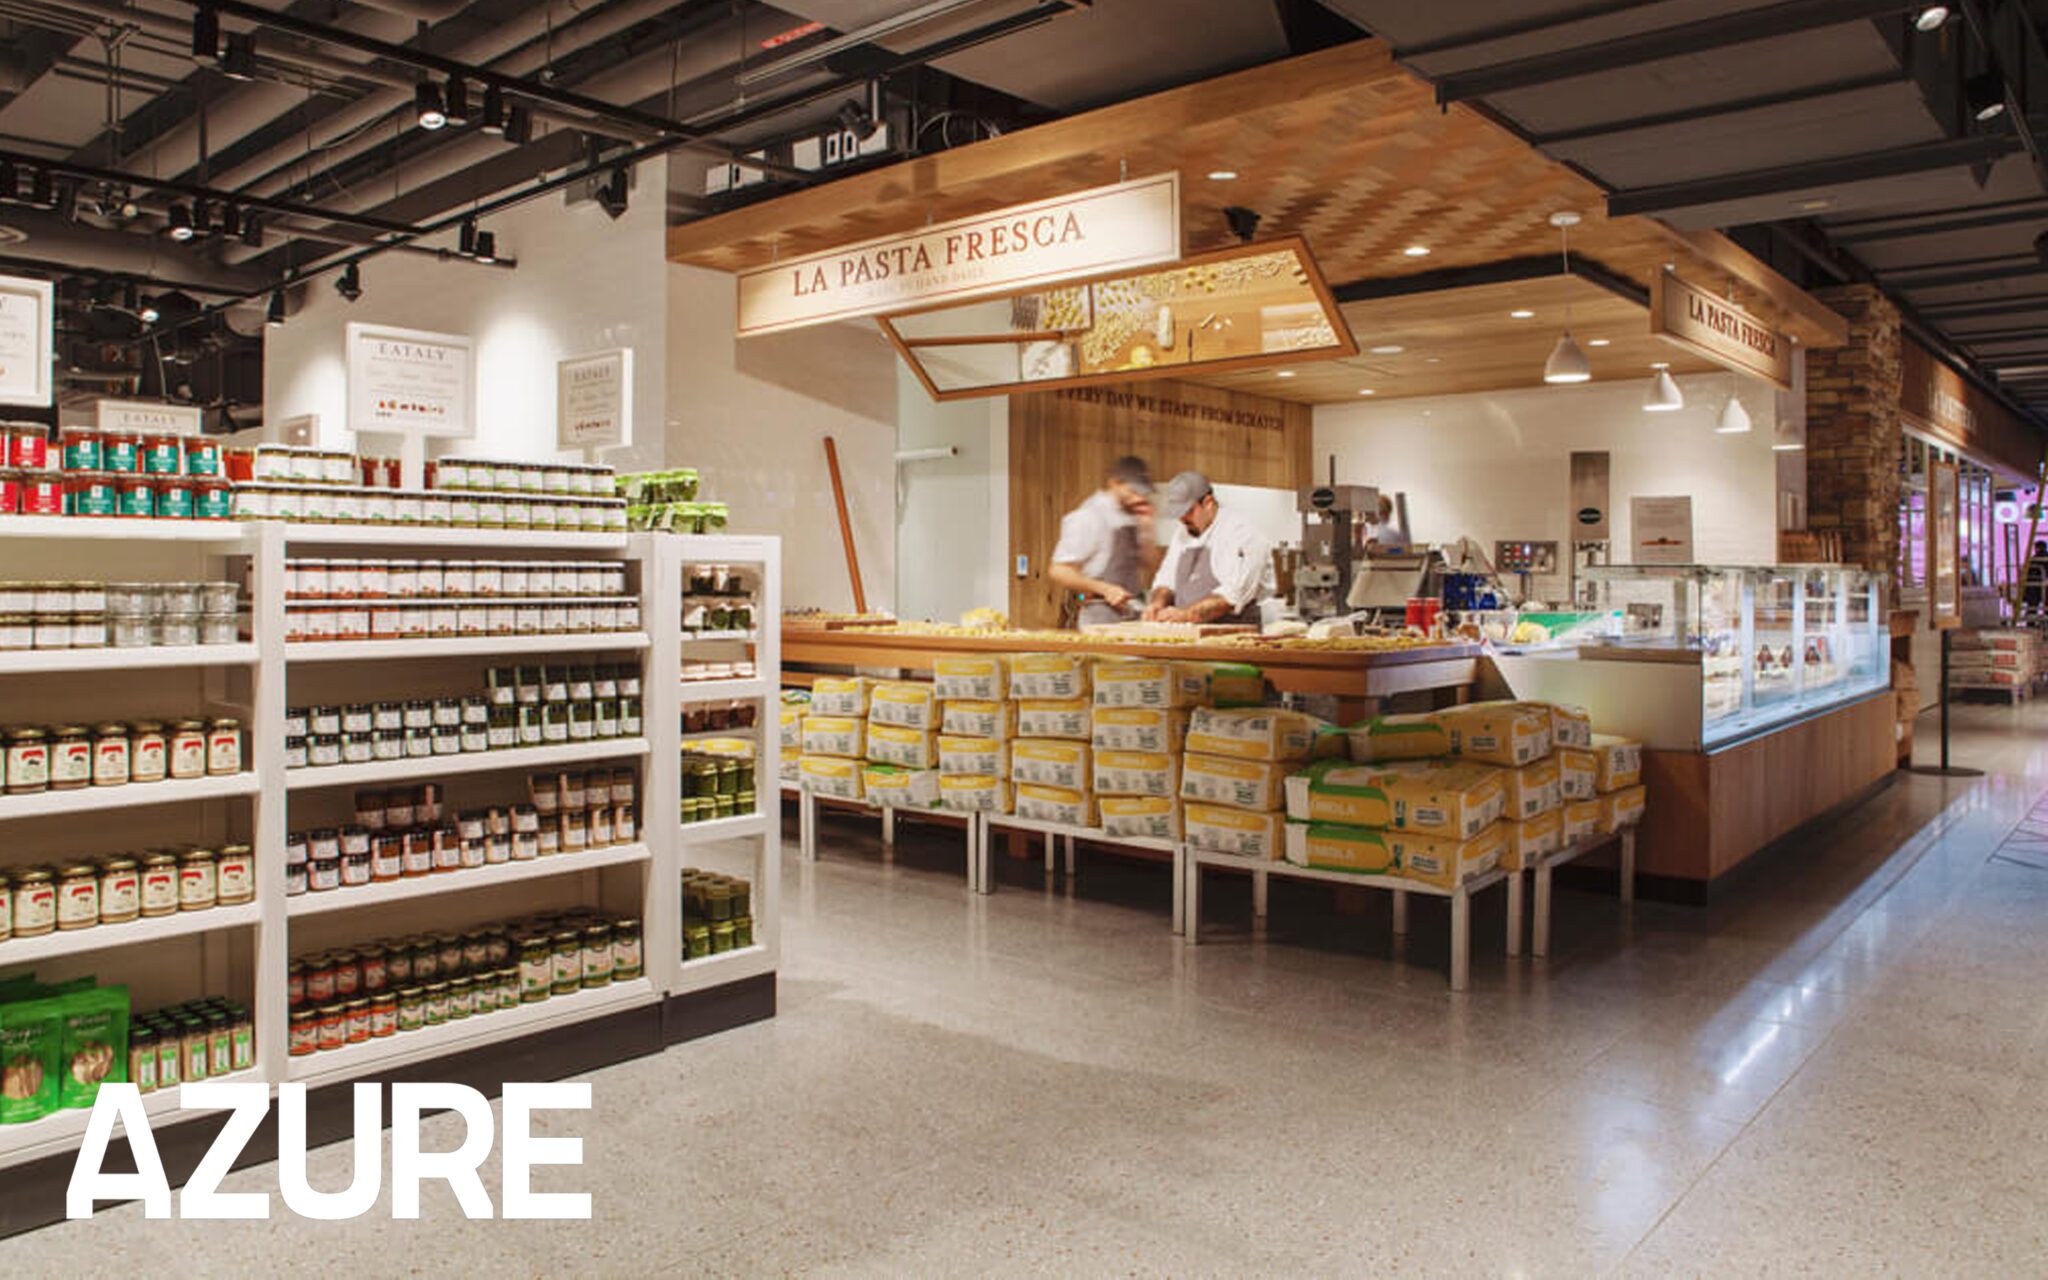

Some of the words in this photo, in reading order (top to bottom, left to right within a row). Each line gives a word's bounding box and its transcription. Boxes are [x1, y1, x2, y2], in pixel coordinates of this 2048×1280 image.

[793, 265, 828, 297] LA
[840, 242, 932, 287] PASTA
[945, 210, 1086, 265] FRESCA
[377, 342, 447, 361] EATALY
[1689, 295, 1704, 324] LA
[1707, 303, 1740, 341] PASTA
[1741, 322, 1776, 359] FRESCA
[1057, 386, 1101, 404] EVERY
[1106, 390, 1134, 410] DAY
[1136, 394, 1154, 413] WE
[1158, 398, 1197, 418] START
[1201, 405, 1234, 425] FROM
[1235, 409, 1285, 432] SCRATCH
